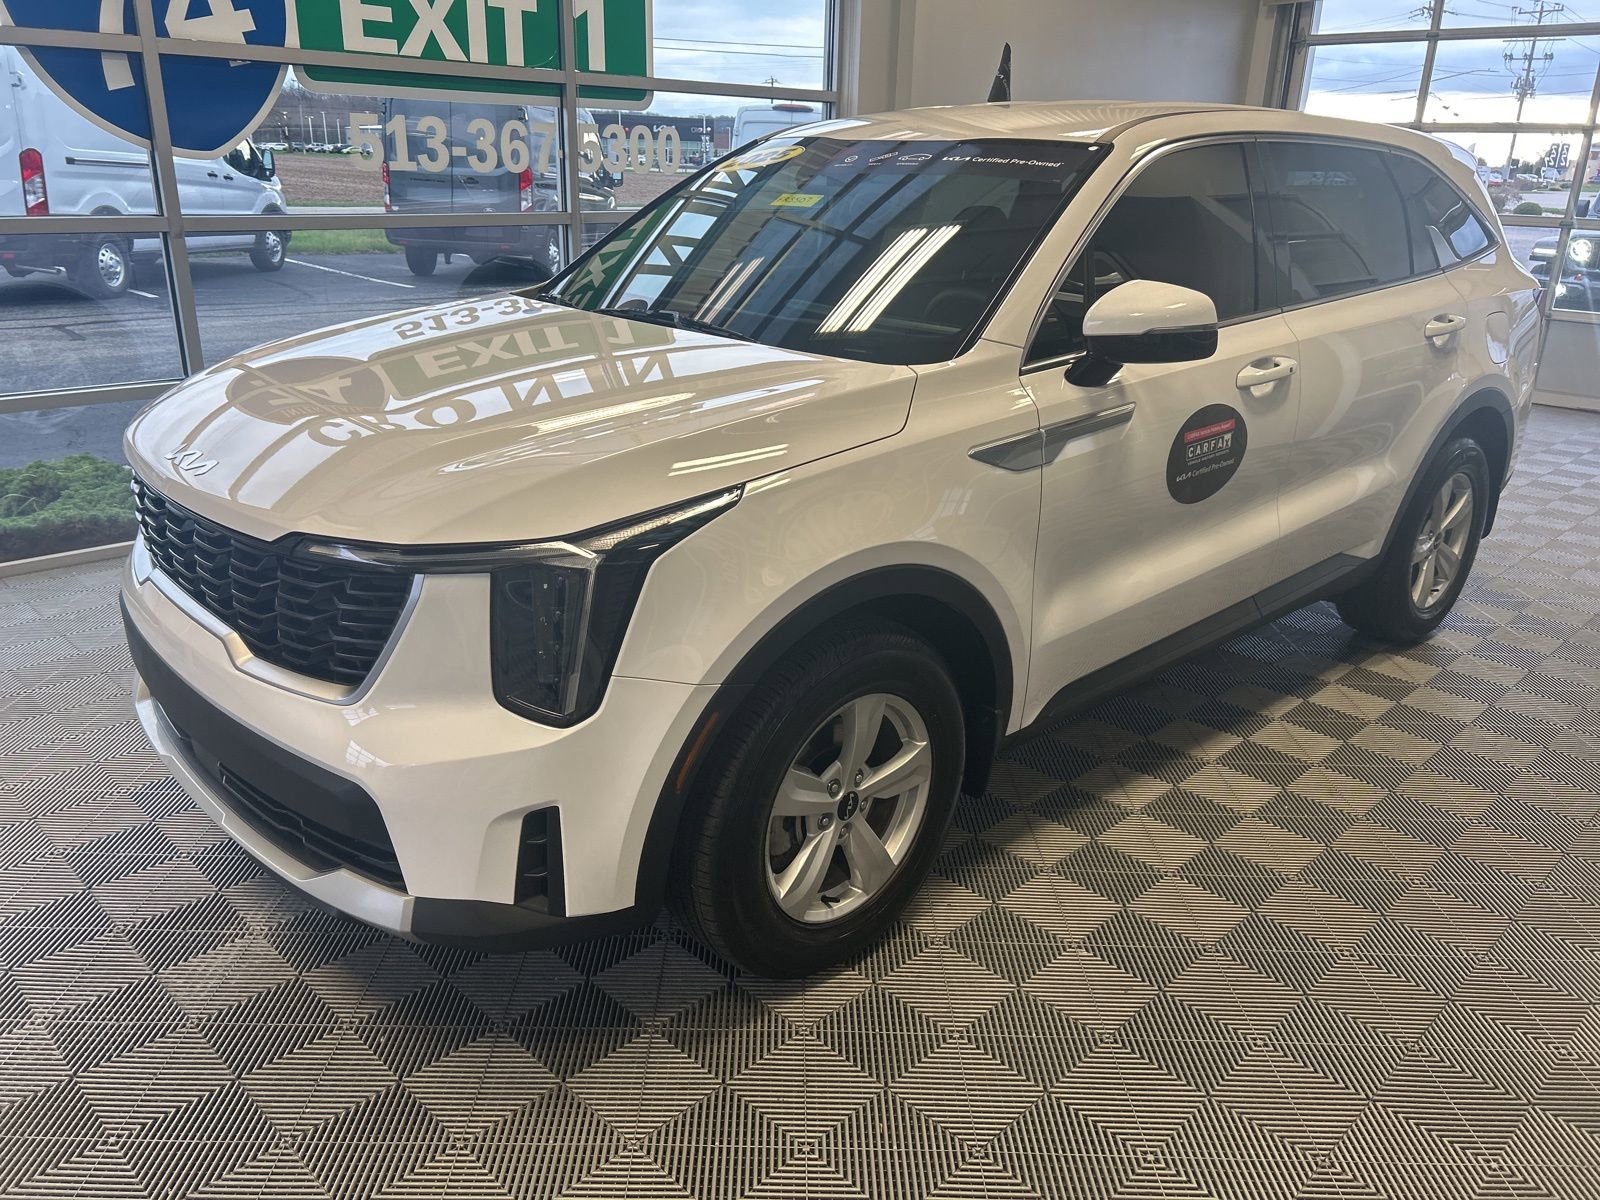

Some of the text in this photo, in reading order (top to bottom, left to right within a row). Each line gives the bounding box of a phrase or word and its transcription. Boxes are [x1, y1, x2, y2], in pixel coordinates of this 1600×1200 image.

[338, 0, 538, 67] EXIT
[1010, 158, 1062, 168] Pre-Owned
[1187, 437, 1232, 458] CARFAX
[1192, 464, 1211, 479] Certified
